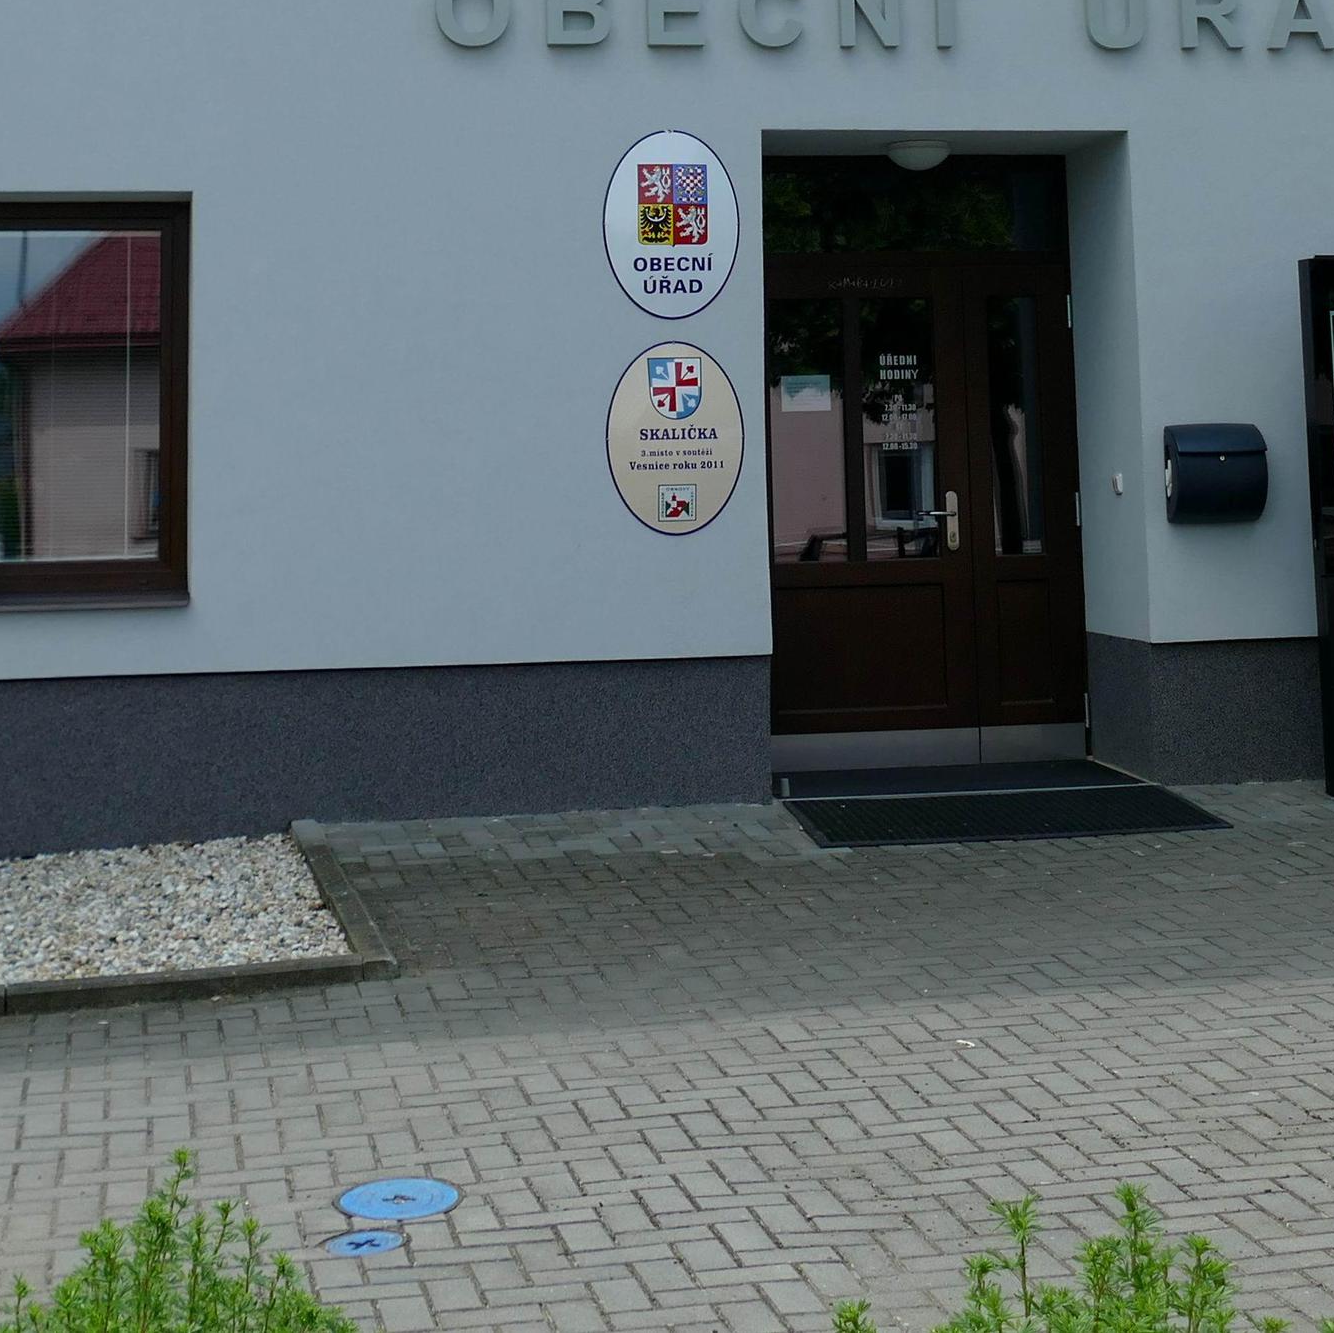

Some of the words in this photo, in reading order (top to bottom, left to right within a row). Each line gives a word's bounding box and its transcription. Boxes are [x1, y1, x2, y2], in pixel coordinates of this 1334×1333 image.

[633, 253, 713, 272] OBECNÍ
[643, 275, 703, 294] ÚŘAD
[880, 369, 918, 380] HODINY
[640, 424, 718, 441] SKALIČKA
[629, 461, 670, 471] Vesnice
[673, 460, 697, 470] roku
[700, 460, 724, 469] 2011
